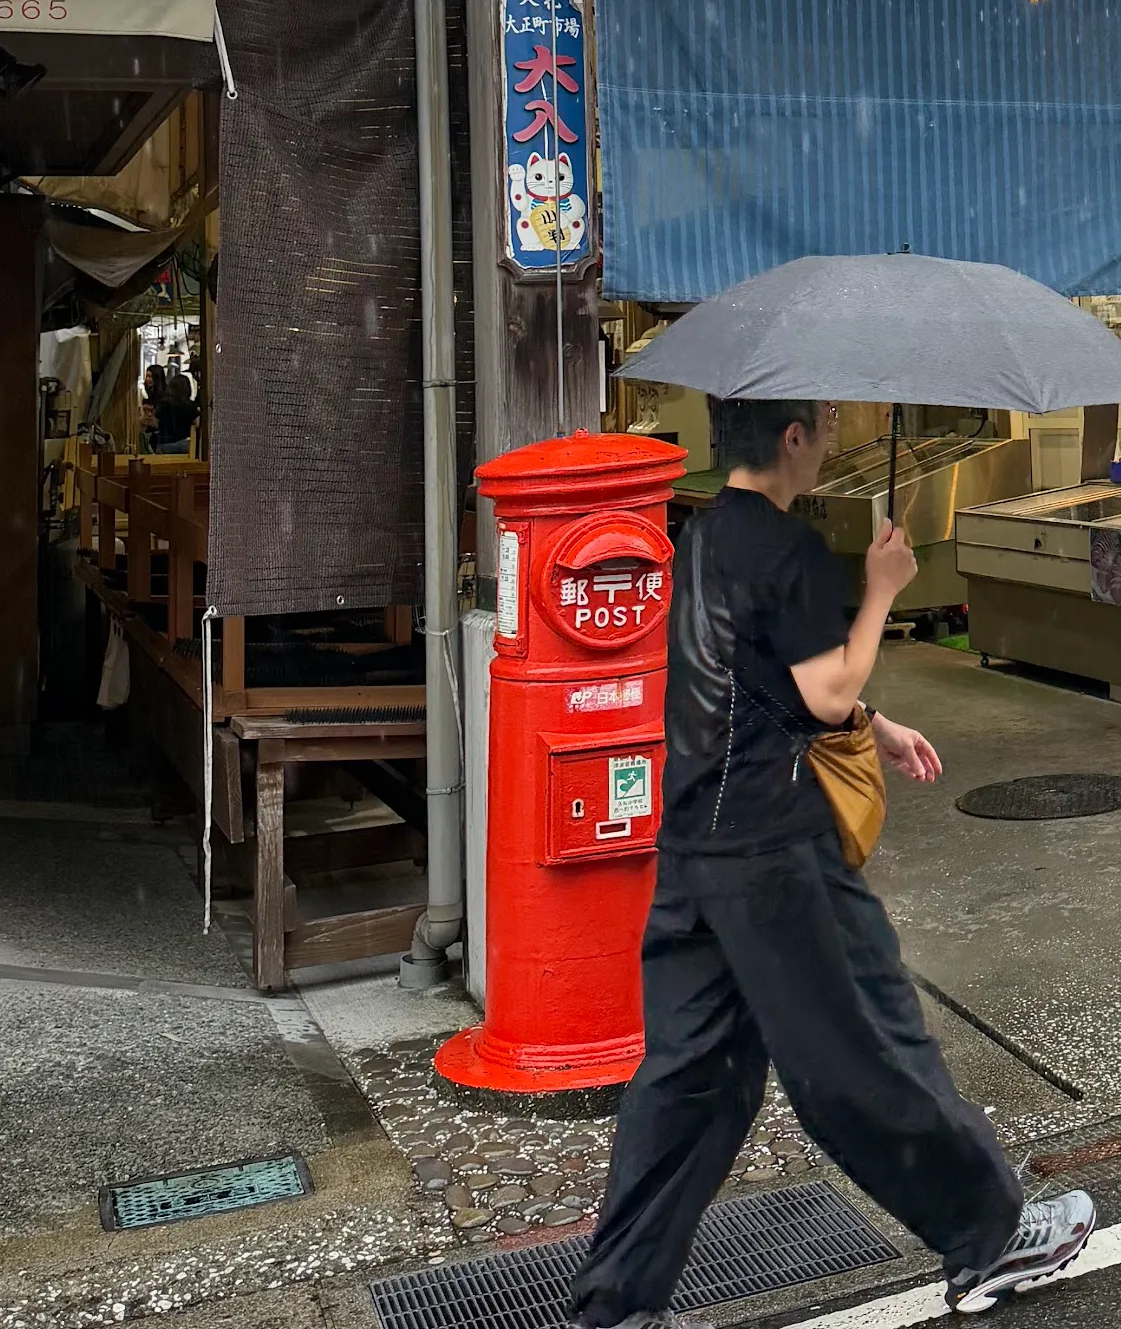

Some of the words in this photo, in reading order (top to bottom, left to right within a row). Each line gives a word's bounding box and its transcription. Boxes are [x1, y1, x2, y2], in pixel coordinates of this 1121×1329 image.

[506, 14, 581, 39] 大正町市場
[513, 44, 580, 144] 大入
[575, 605, 646, 629] POST
